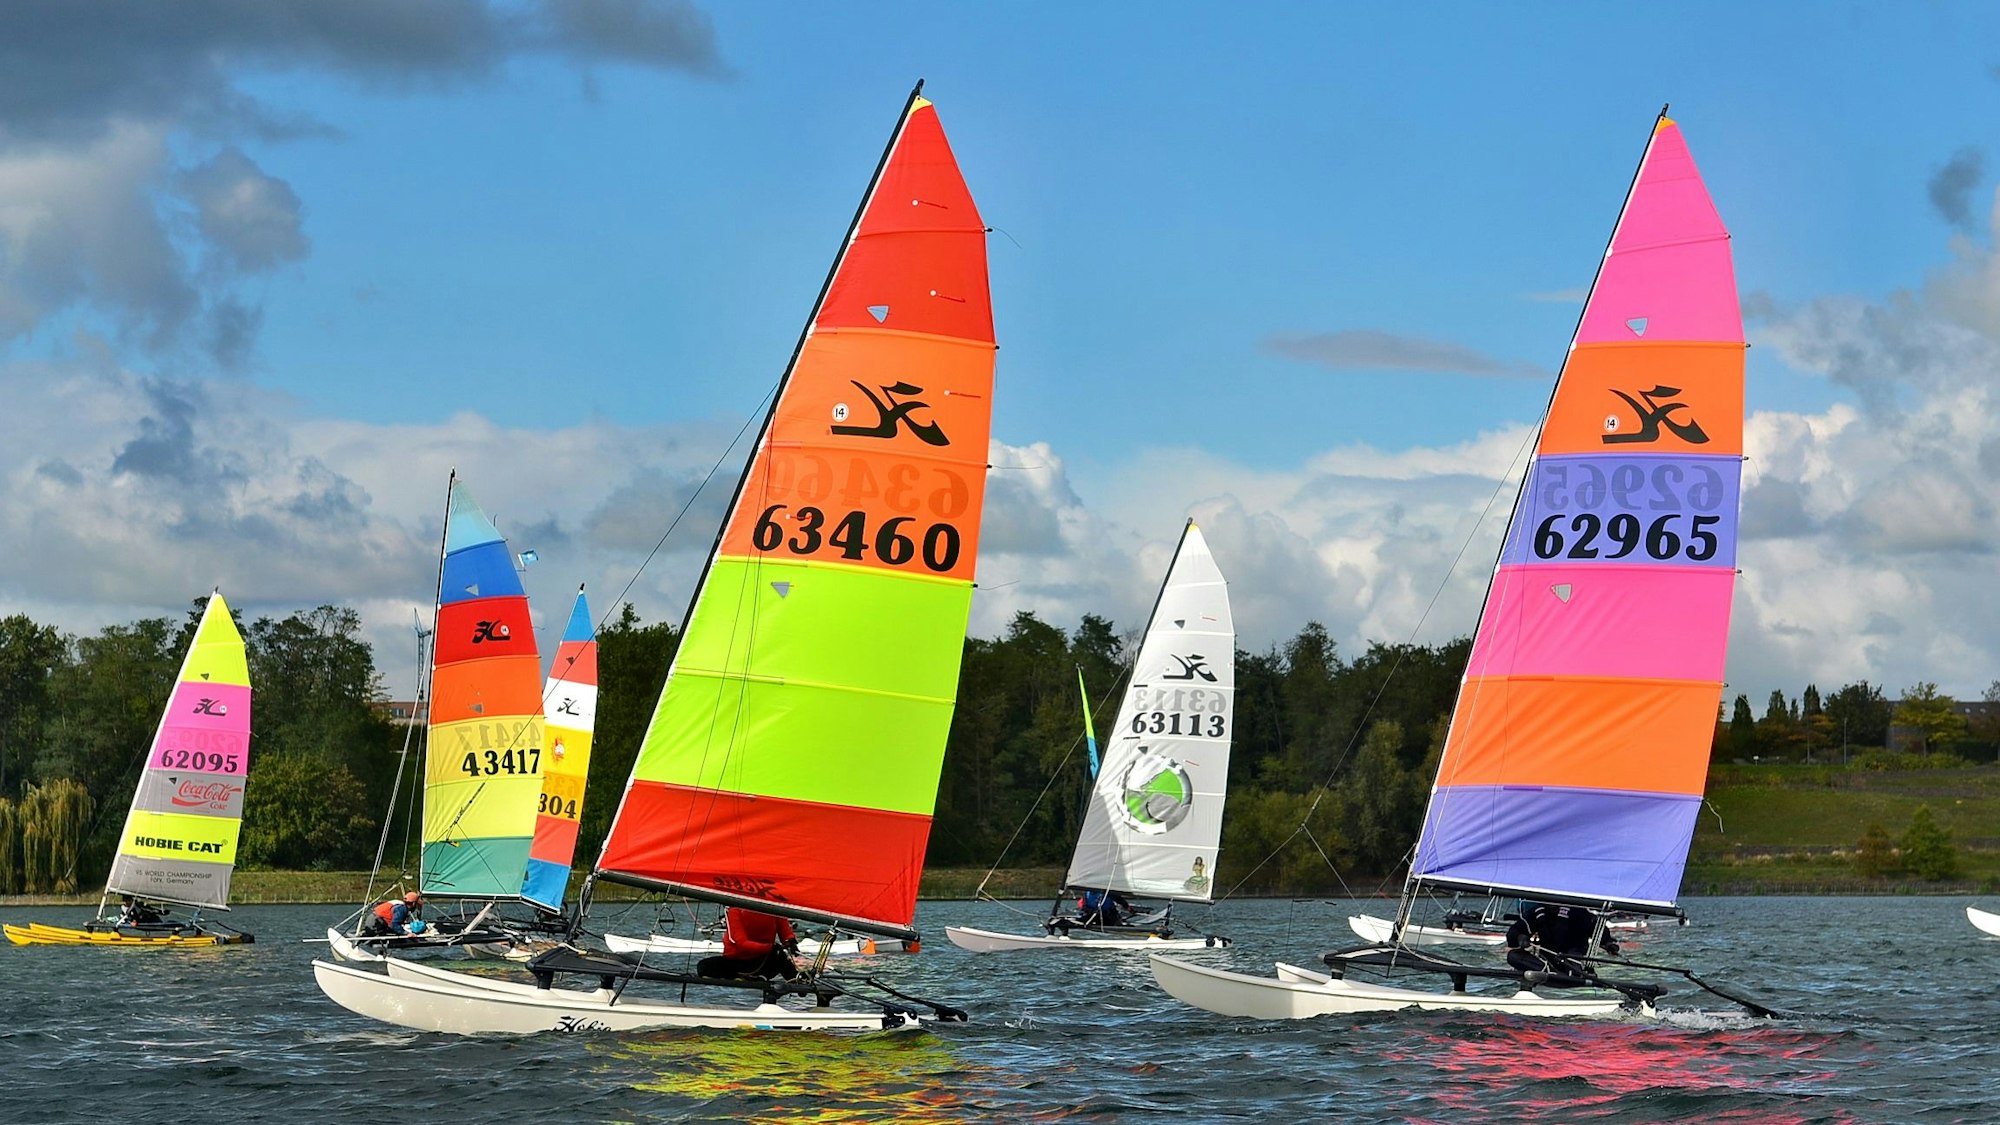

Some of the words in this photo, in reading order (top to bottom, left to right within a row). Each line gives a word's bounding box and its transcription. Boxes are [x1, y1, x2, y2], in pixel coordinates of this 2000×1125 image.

[835, 406, 846, 418] 14
[1607, 417, 1617, 428] 14
[752, 503, 960, 572] 63460
[1533, 513, 1721, 560] 62965
[1131, 711, 1225, 738] 63113
[161, 749, 238, 773] 62095
[462, 748, 541, 777] 43417
[135, 836, 183, 851] HOBIE
[187, 841, 223, 854] CAT
[166, 871, 213, 879] CHAMPIONSHIP
[166, 877, 195, 885] Germany
